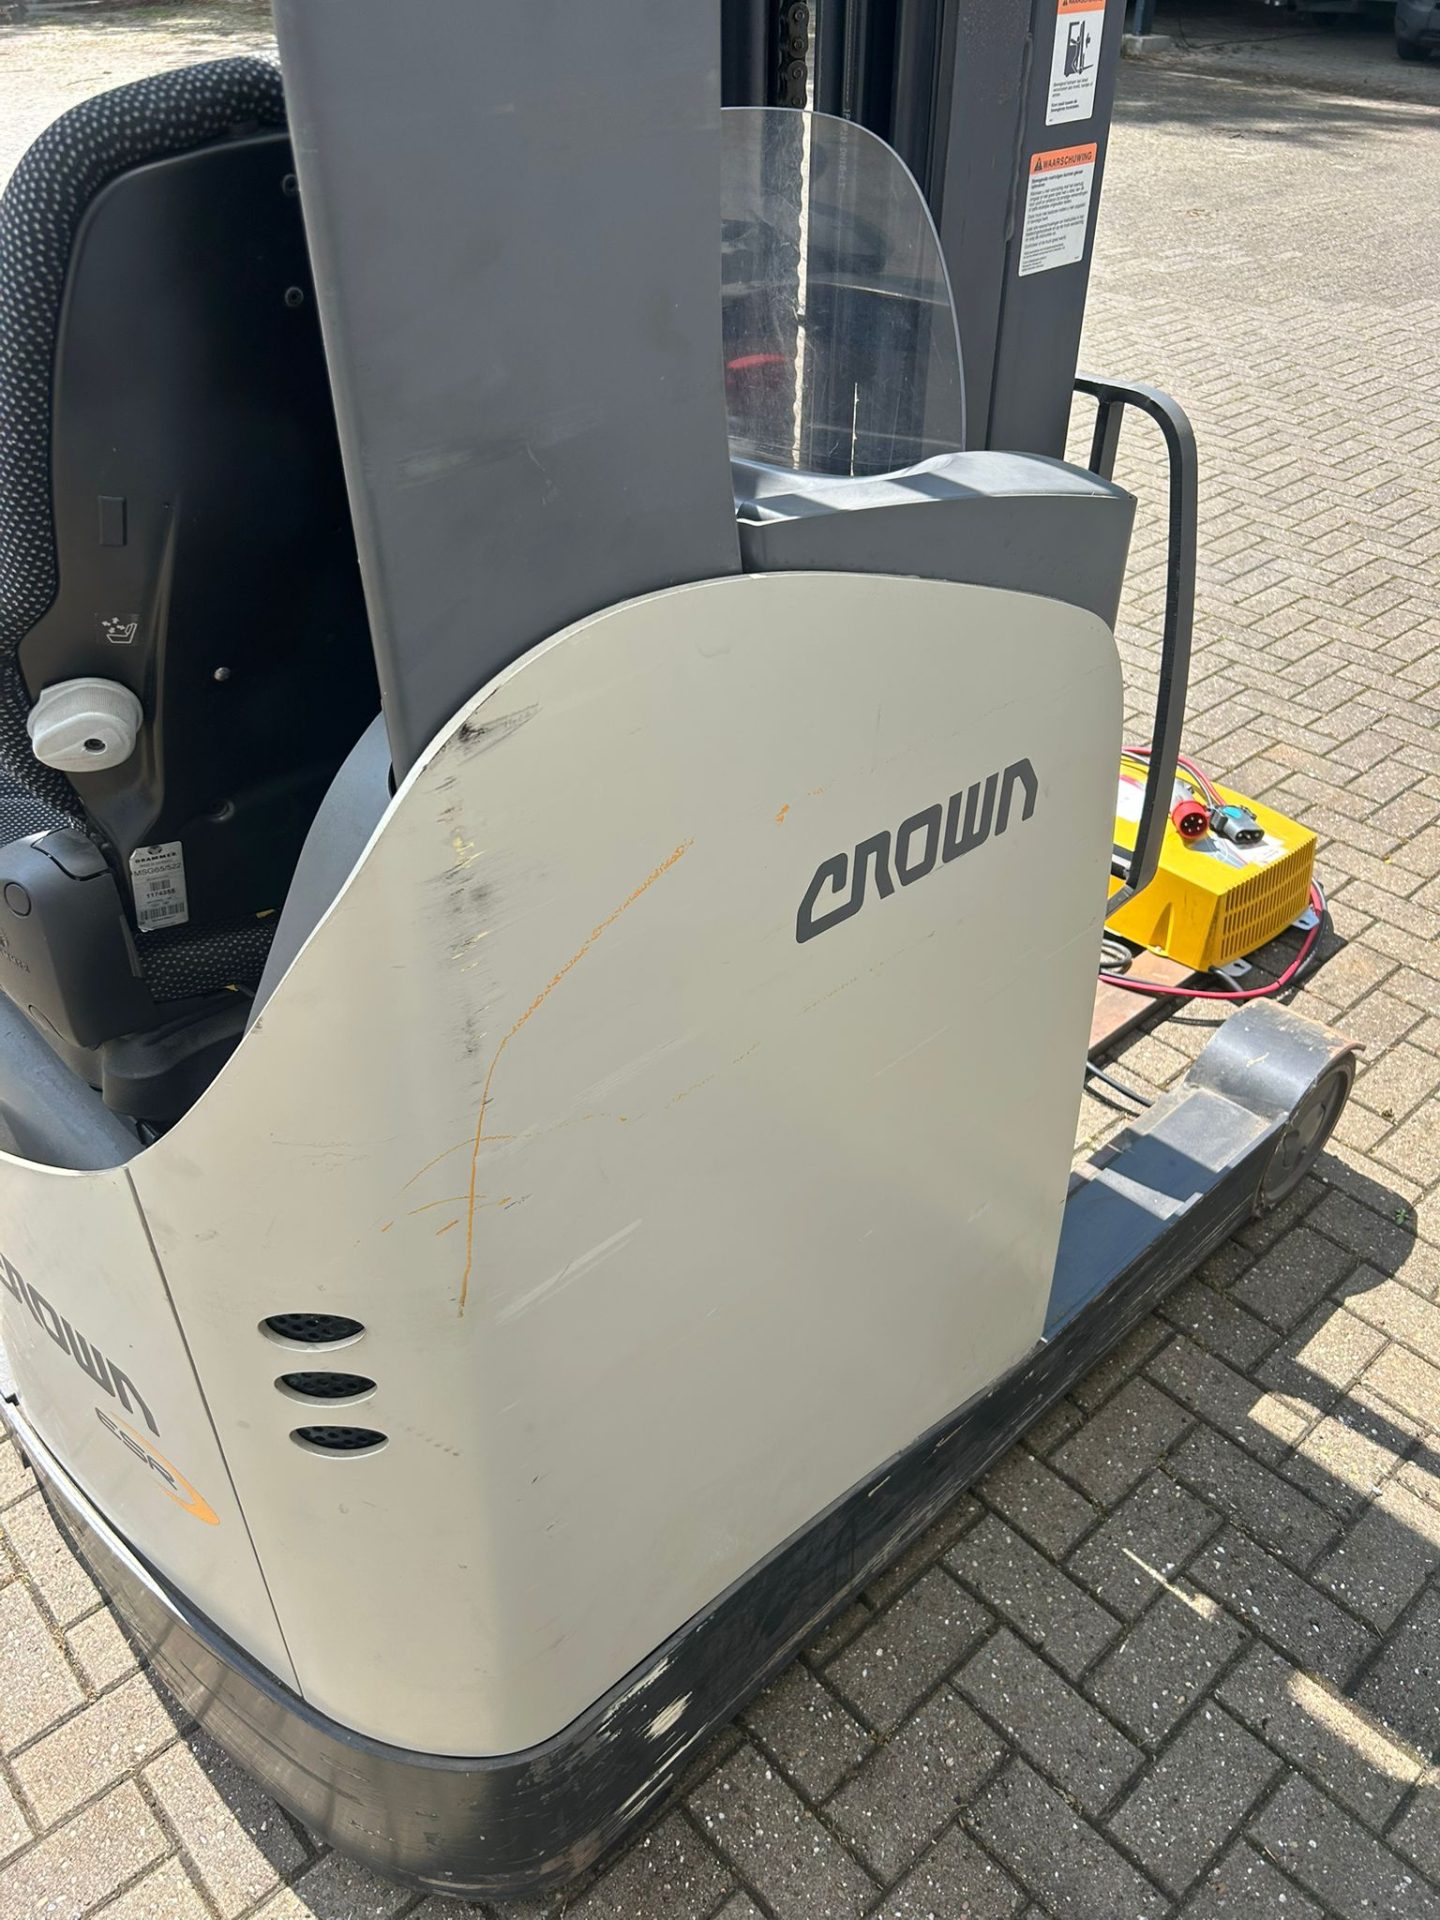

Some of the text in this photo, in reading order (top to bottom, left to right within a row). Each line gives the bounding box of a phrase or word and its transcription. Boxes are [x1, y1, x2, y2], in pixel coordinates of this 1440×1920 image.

[1042, 151, 1093, 169] WAARSCHUWING
[795, 757, 1039, 944] CROWN
[0, 1252, 160, 1438] ROWN
[95, 1407, 178, 1491] ESR
